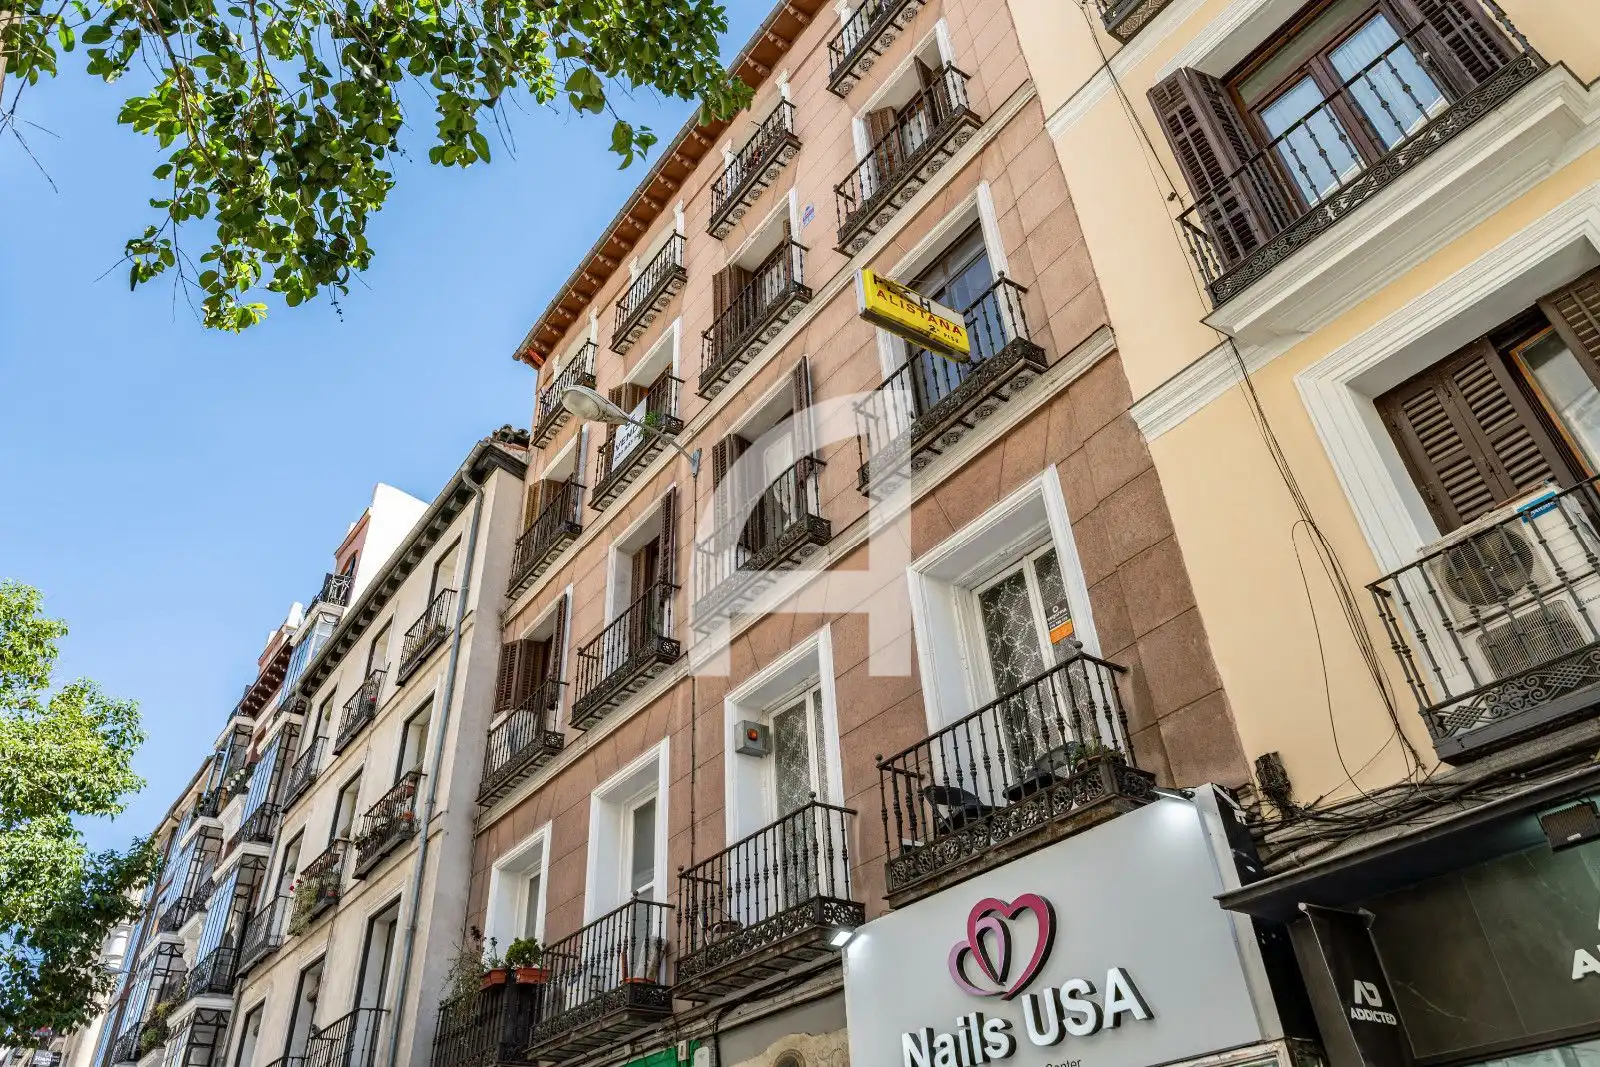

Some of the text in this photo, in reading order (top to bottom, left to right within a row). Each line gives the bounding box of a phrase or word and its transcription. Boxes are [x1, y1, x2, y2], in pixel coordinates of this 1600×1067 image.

[877, 289, 962, 337] ALISTANA
[901, 967, 1155, 1067] Nails USA
[1350, 1007, 1397, 1026] ADDICTED
